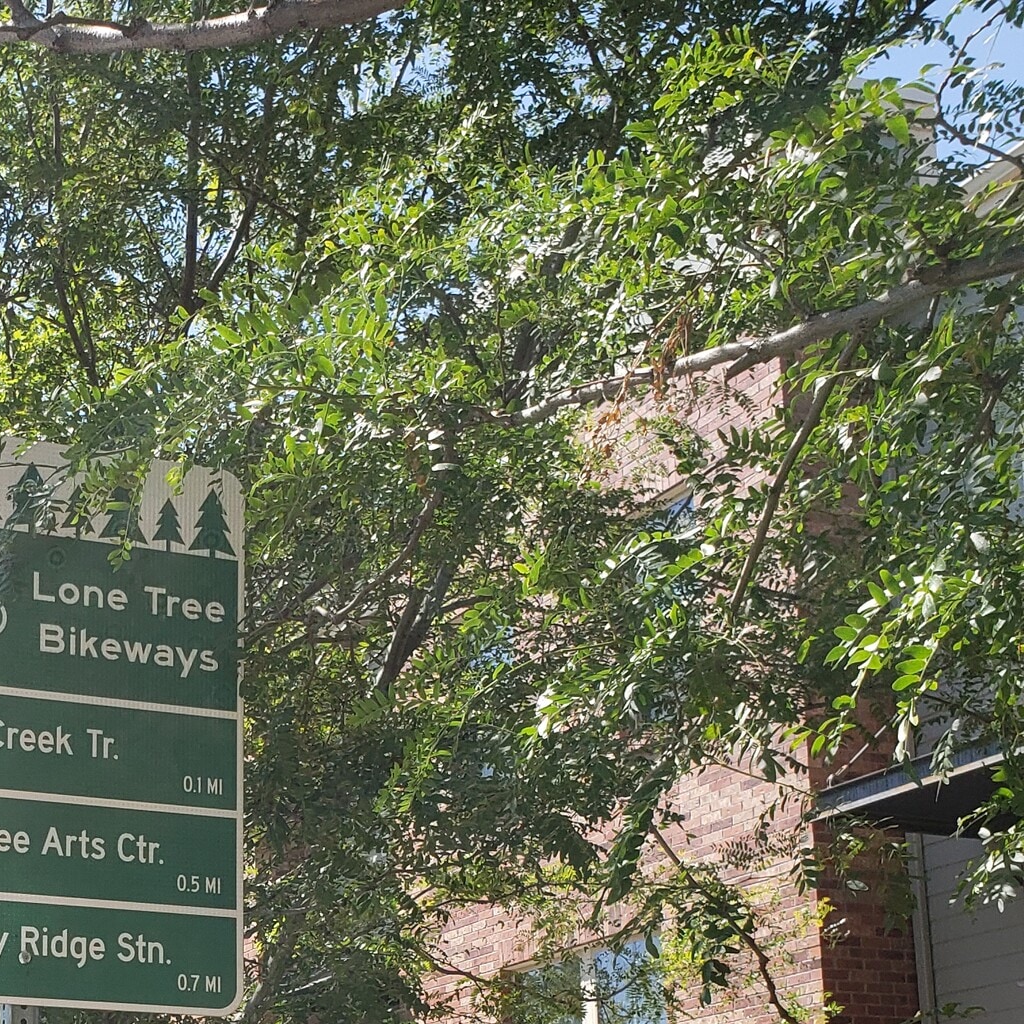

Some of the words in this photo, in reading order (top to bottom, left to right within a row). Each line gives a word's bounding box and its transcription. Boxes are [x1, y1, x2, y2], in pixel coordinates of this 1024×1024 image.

[33, 571, 128, 610] Lone
[145, 586, 226, 624] Tree
[40, 624, 220, 678] Bikeways
[87, 730, 119, 760] Tr.
[183, 775, 203, 794] 0.1
[206, 778, 223, 795] MI
[41, 826, 105, 859] Arts
[117, 833, 164, 865] Ctr.
[177, 875, 201, 893] 0.5
[205, 877, 221, 894] MI
[20, 926, 106, 968] Ridge
[117, 932, 172, 965] Stn.
[177, 974, 201, 992] 0.7
[205, 976, 221, 993] MI
